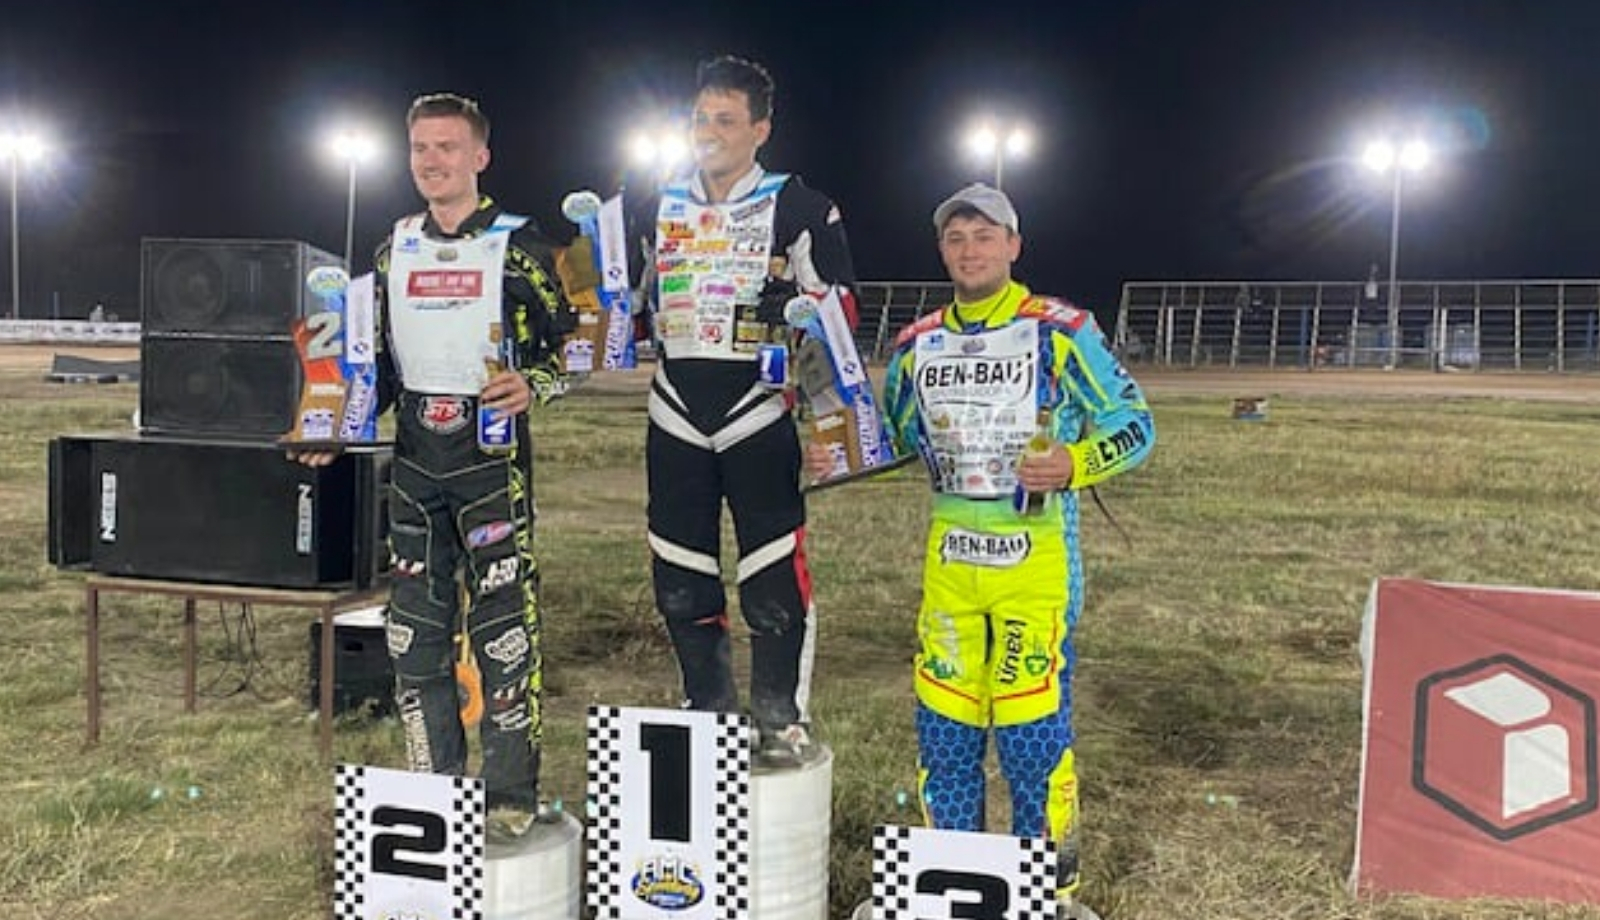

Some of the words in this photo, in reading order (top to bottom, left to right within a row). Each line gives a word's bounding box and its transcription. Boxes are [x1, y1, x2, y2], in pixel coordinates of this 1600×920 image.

[306, 312, 343, 359] 2
[640, 722, 691, 842] 1
[371, 805, 447, 882] 2
[915, 869, 1010, 920] 3
